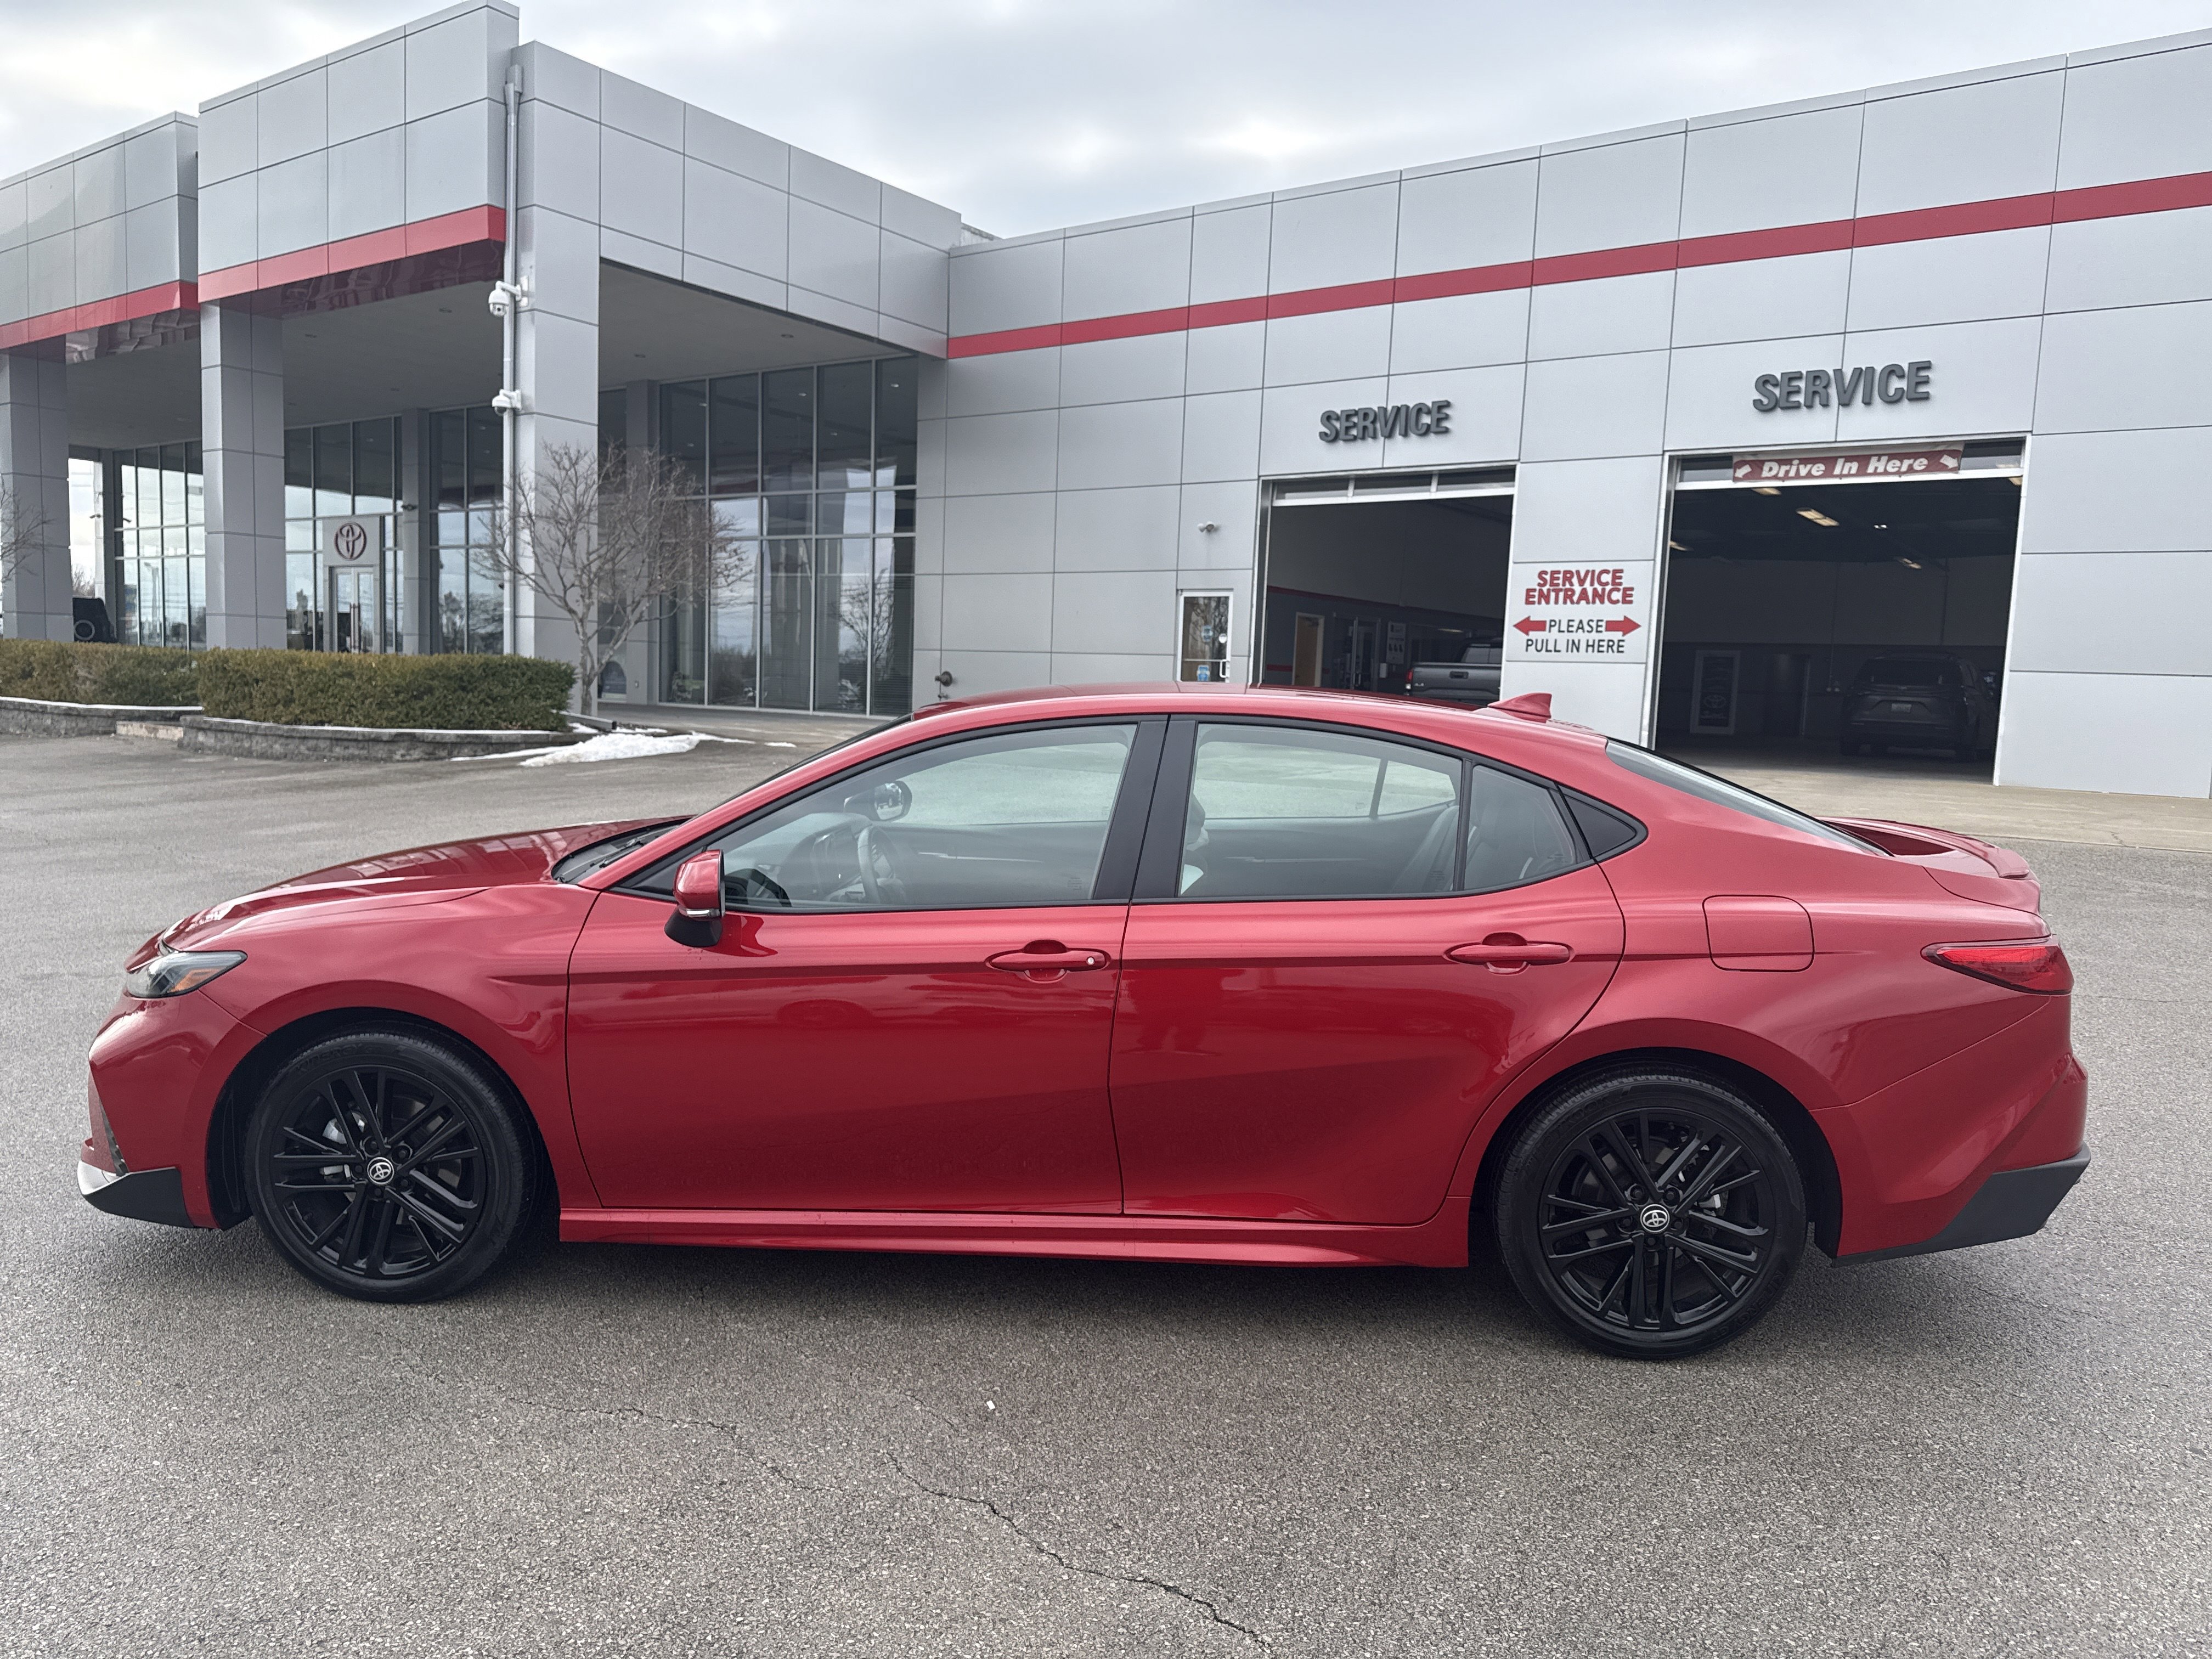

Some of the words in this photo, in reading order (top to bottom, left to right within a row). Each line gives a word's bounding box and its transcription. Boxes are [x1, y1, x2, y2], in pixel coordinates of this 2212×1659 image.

[1752, 360, 1932, 411] SERVICE
[1319, 400, 1451, 443] SERVICE
[1760, 459, 1826, 478] Drive
[1833, 458, 1859, 475] In
[1866, 455, 1928, 473] Here
[1537, 569, 1624, 586] SERVICE
[1525, 587, 1634, 605] ENTRANCE
[1548, 619, 1604, 634] PLEASE
[1525, 639, 1561, 653] PULL
[1566, 639, 1581, 653] IN
[1585, 639, 1625, 653] HERE
